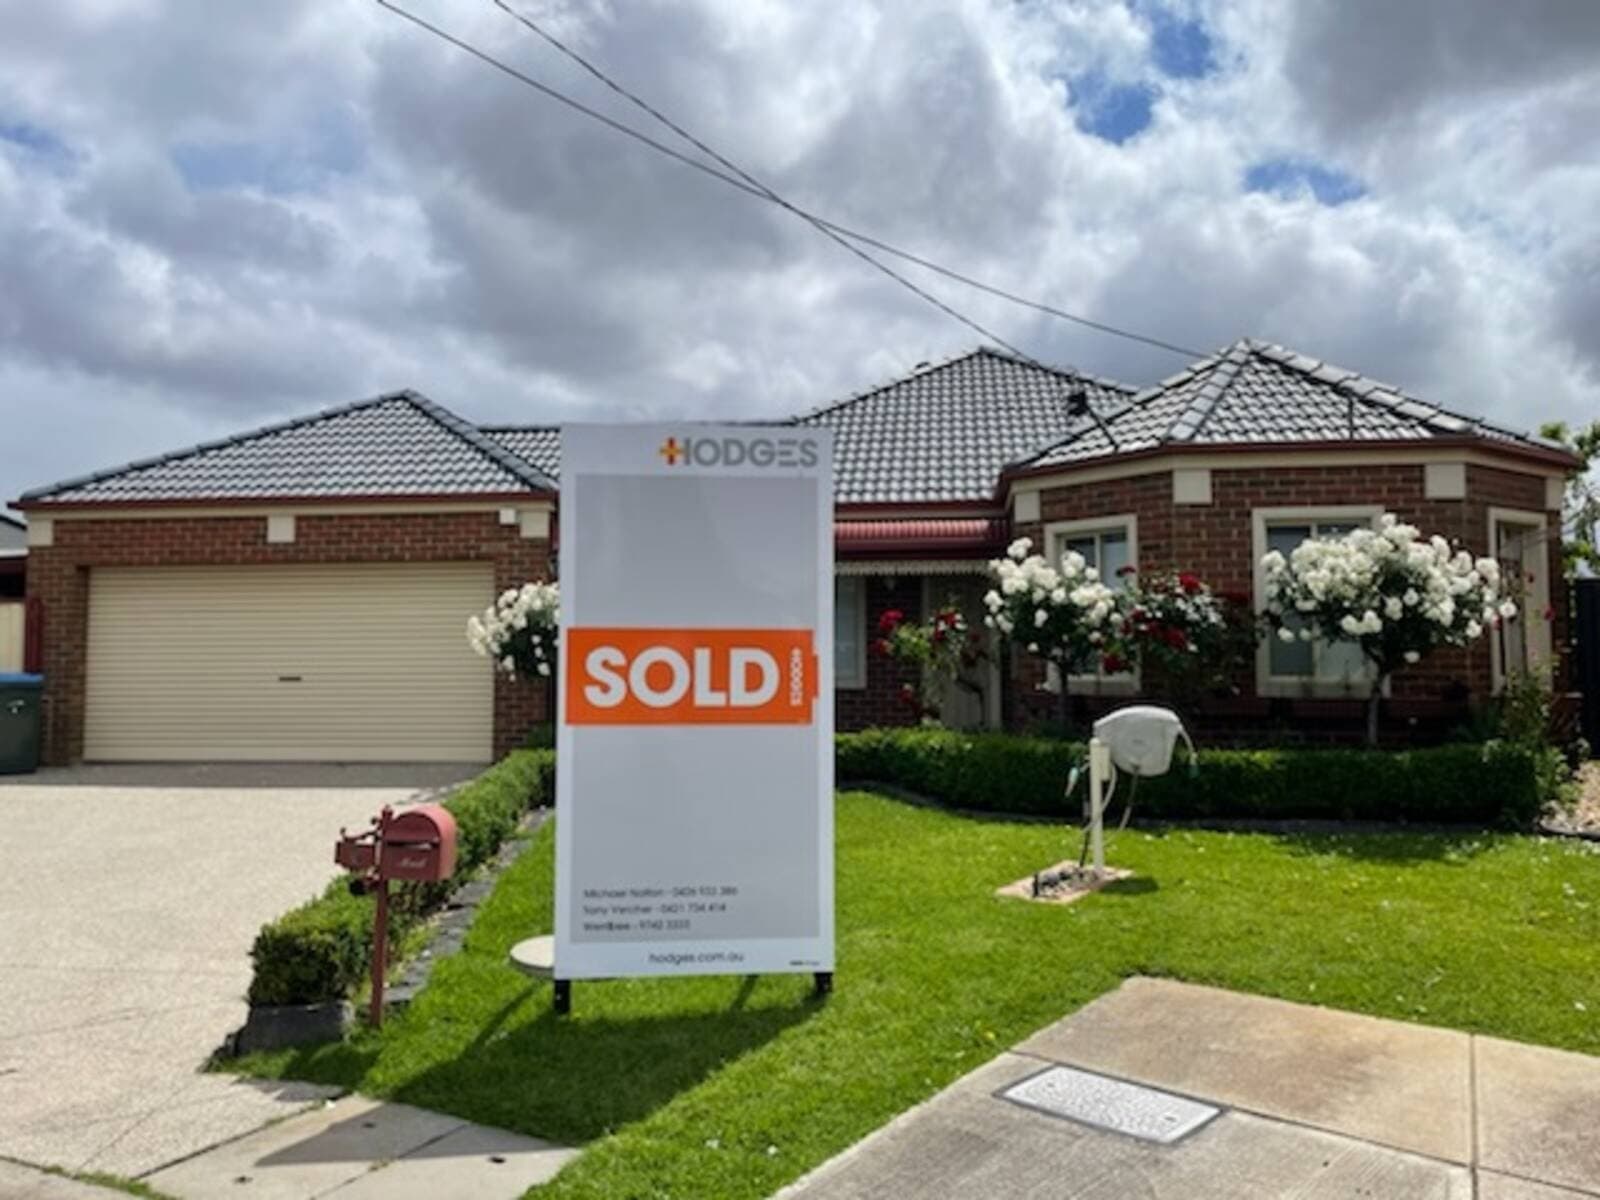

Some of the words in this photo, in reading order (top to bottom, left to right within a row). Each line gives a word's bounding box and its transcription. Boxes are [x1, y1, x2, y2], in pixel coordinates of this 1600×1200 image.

[659, 436, 819, 468] HODGES
[583, 645, 781, 708] SOLD
[648, 951, 745, 966] hodges.com.au
